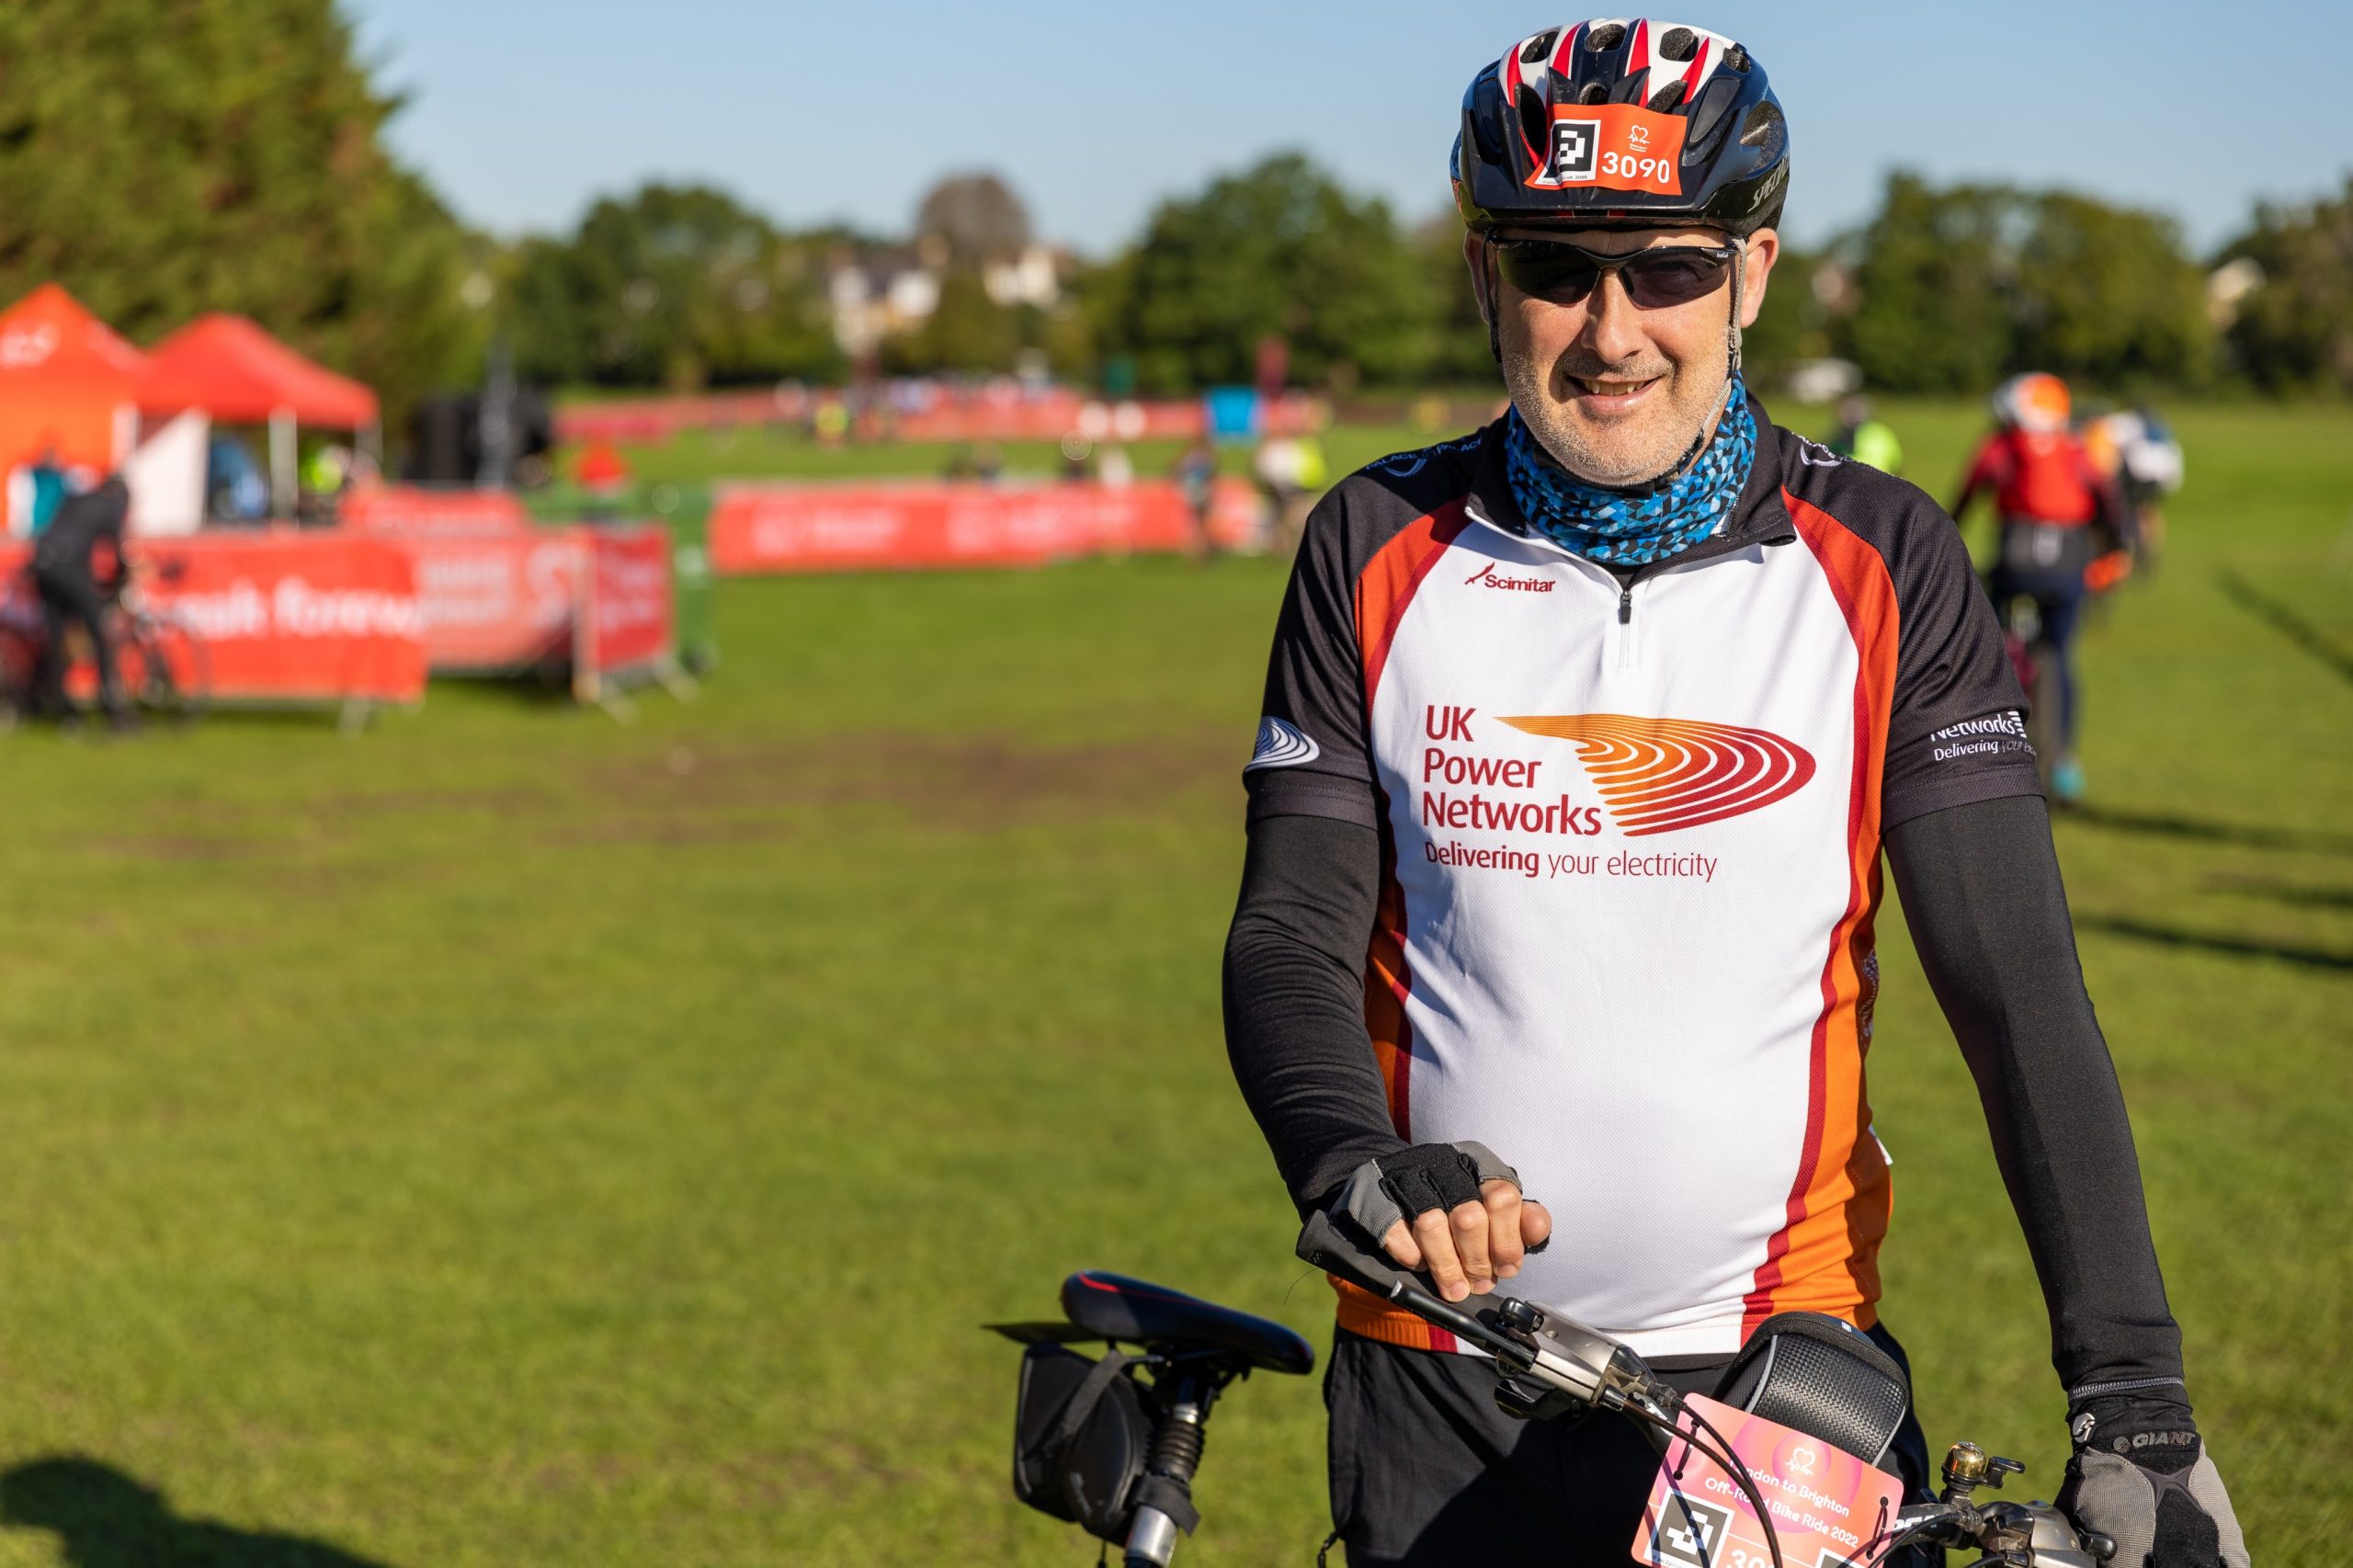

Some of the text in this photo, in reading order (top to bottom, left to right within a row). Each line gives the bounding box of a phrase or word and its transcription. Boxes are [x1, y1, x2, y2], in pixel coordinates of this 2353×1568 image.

[1602, 152, 1670, 184] 3090
[1484, 574, 1556, 593] Scimitar
[1426, 704, 1476, 743] UK
[1424, 747, 1542, 790] Power
[1933, 739, 1999, 762] Delivering
[1423, 791, 1602, 836] Networks
[1425, 840, 1719, 883] Delivering your electricity
[2131, 1430, 2196, 1449] GIANT
[1730, 1460, 1850, 1517] ndon to Brighton
[1705, 1477, 1859, 1549] Off-Rod Bike Ride 2022
